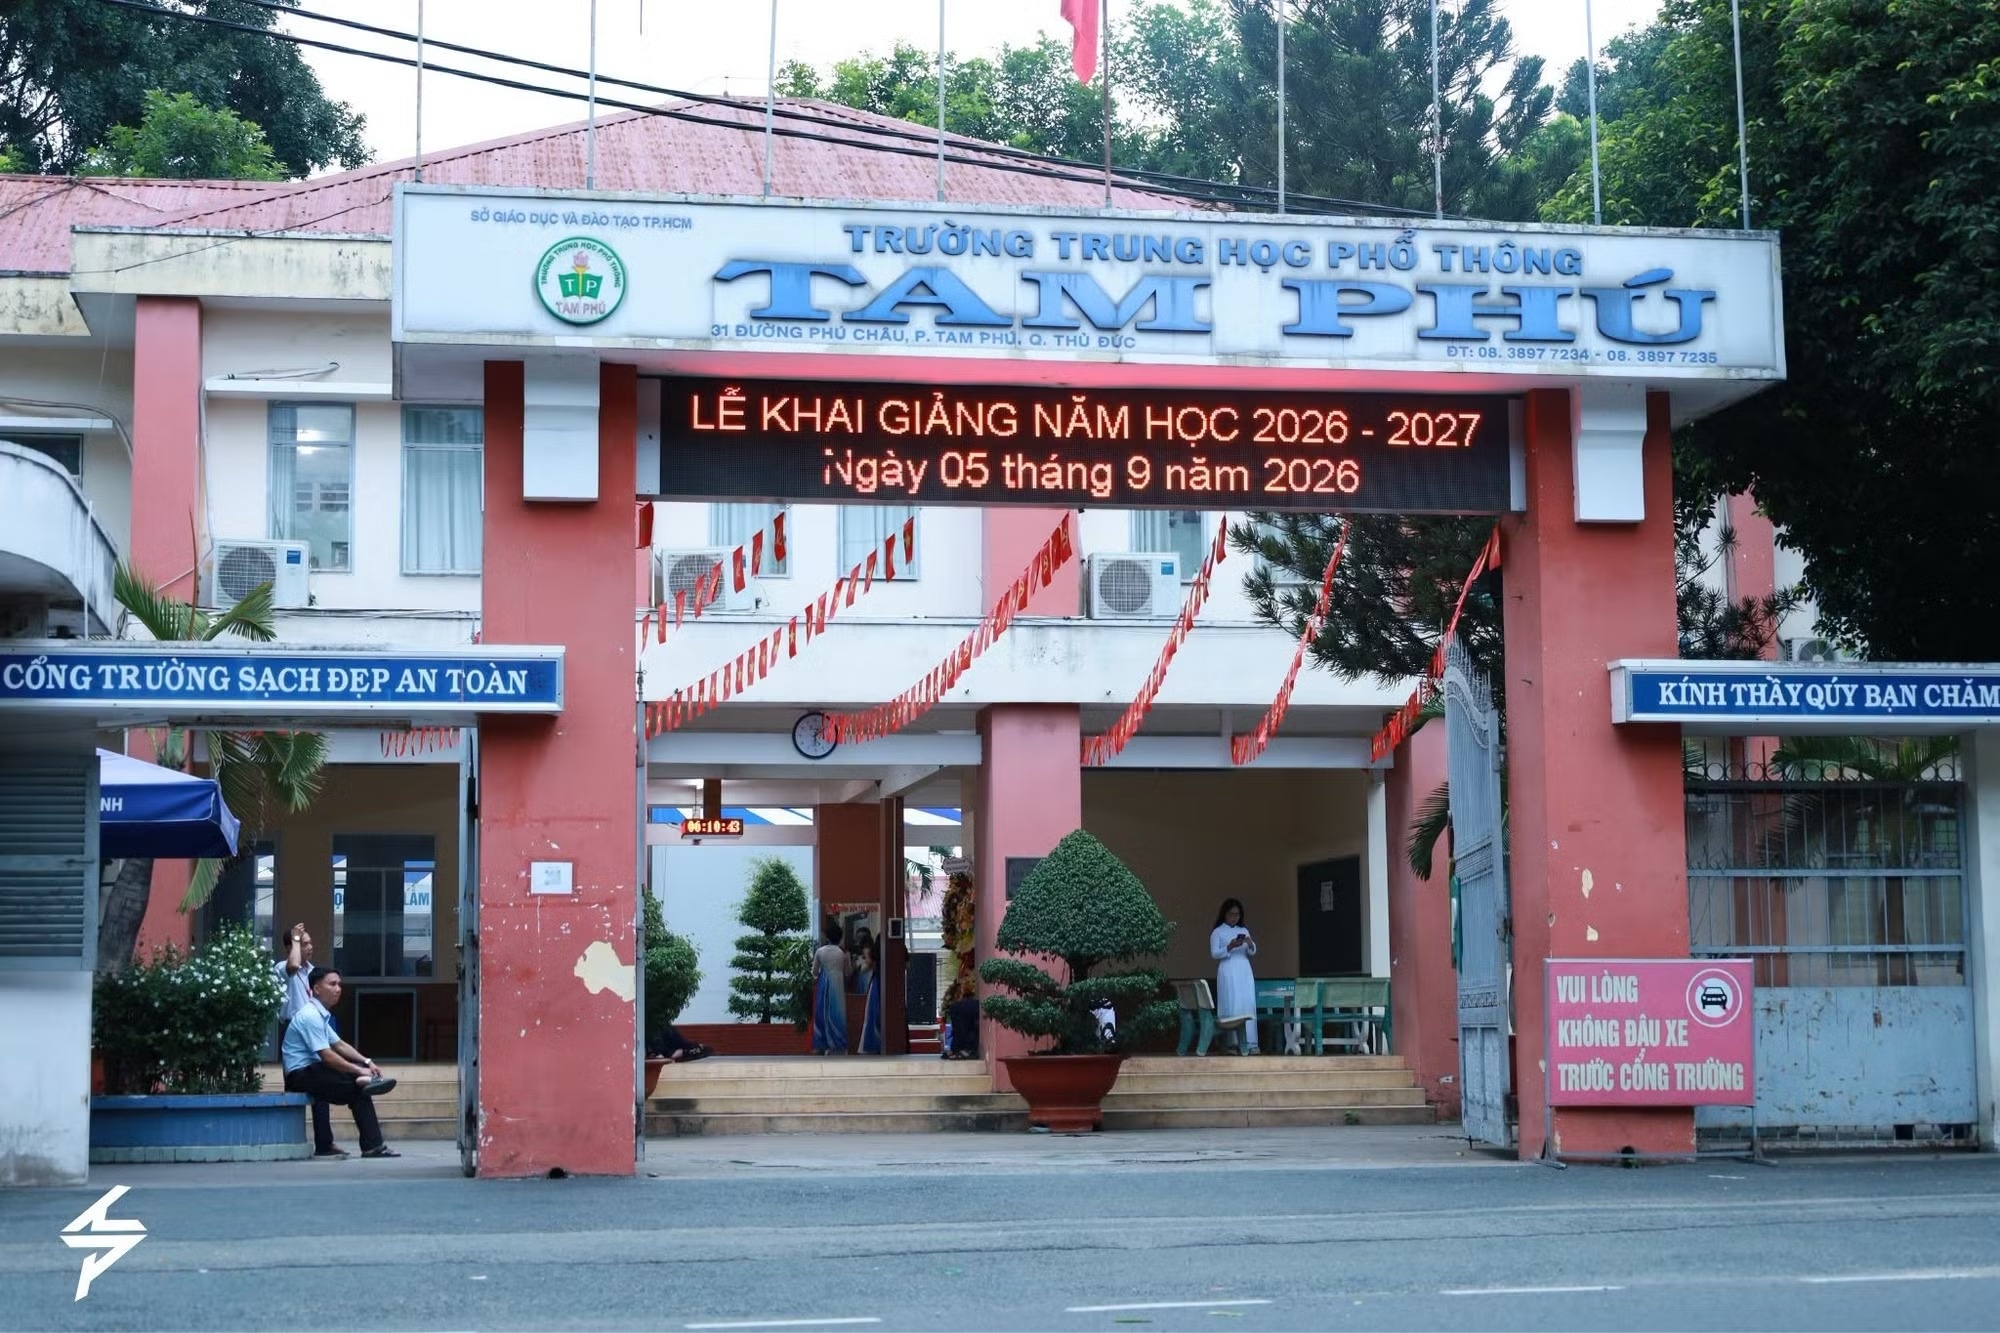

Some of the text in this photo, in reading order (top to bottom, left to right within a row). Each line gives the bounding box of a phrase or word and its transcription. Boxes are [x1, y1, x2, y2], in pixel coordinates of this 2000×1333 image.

[471, 207, 692, 230] SỞ GIÁO DỤC VÀ ĐÀO TẠO TP.HCM
[843, 219, 1583, 276] TRƯỜNG TRUNG HỌC PHỔ THÔNG
[556, 301, 606, 314] TAM PHÚ
[713, 259, 1717, 345] TAM PHÚ
[711, 324, 728, 337] 31
[735, 323, 803, 339] ĐƯỜNG
[809, 325, 847, 340] PHÚ
[853, 326, 909, 344] CHÂU,
[915, 331, 930, 343] P.
[935, 331, 973, 344] TAM
[1029, 333, 1046, 347] Q.
[1053, 331, 1090, 348] THỦ
[1098, 333, 1136, 349] ĐỨC
[1447, 344, 1473, 358] ĐT:
[1478, 346, 1502, 359] 08.
[1507, 347, 1545, 360] 3897
[1551, 348, 1589, 361] 7234
[1607, 350, 1631, 362] 08.
[1638, 350, 1674, 363] 3897
[1679, 351, 1718, 363] 7235
[693, 387, 746, 430] LỄ
[763, 396, 863, 433] KHAI
[879, 392, 1017, 437] GIẢNG
[1034, 396, 1129, 440] NĂM
[1146, 406, 1239, 448] HỌC
[1253, 408, 1349, 444] 2026
[1387, 411, 1481, 447] 2027
[824, 449, 1359, 498] Ngày 05 tháng 9 năm 2026
[3, 655, 528, 699] CỔNG TRƯỜNG SẠCH ĐẸP AN TOÀN
[1658, 676, 1727, 706] KÍNH
[1731, 675, 1803, 706] THẦY
[1864, 684, 1917, 713] BẠN
[1923, 678, 2000, 708] CHĂM
[1557, 970, 1638, 1003] VUI LÒNG
[1558, 1013, 1620, 1047] KHÔNG
[1666, 1019, 1688, 1047] XE
[1558, 1053, 1744, 1091] TRƯỚC CỔNG TRƯỜNG
